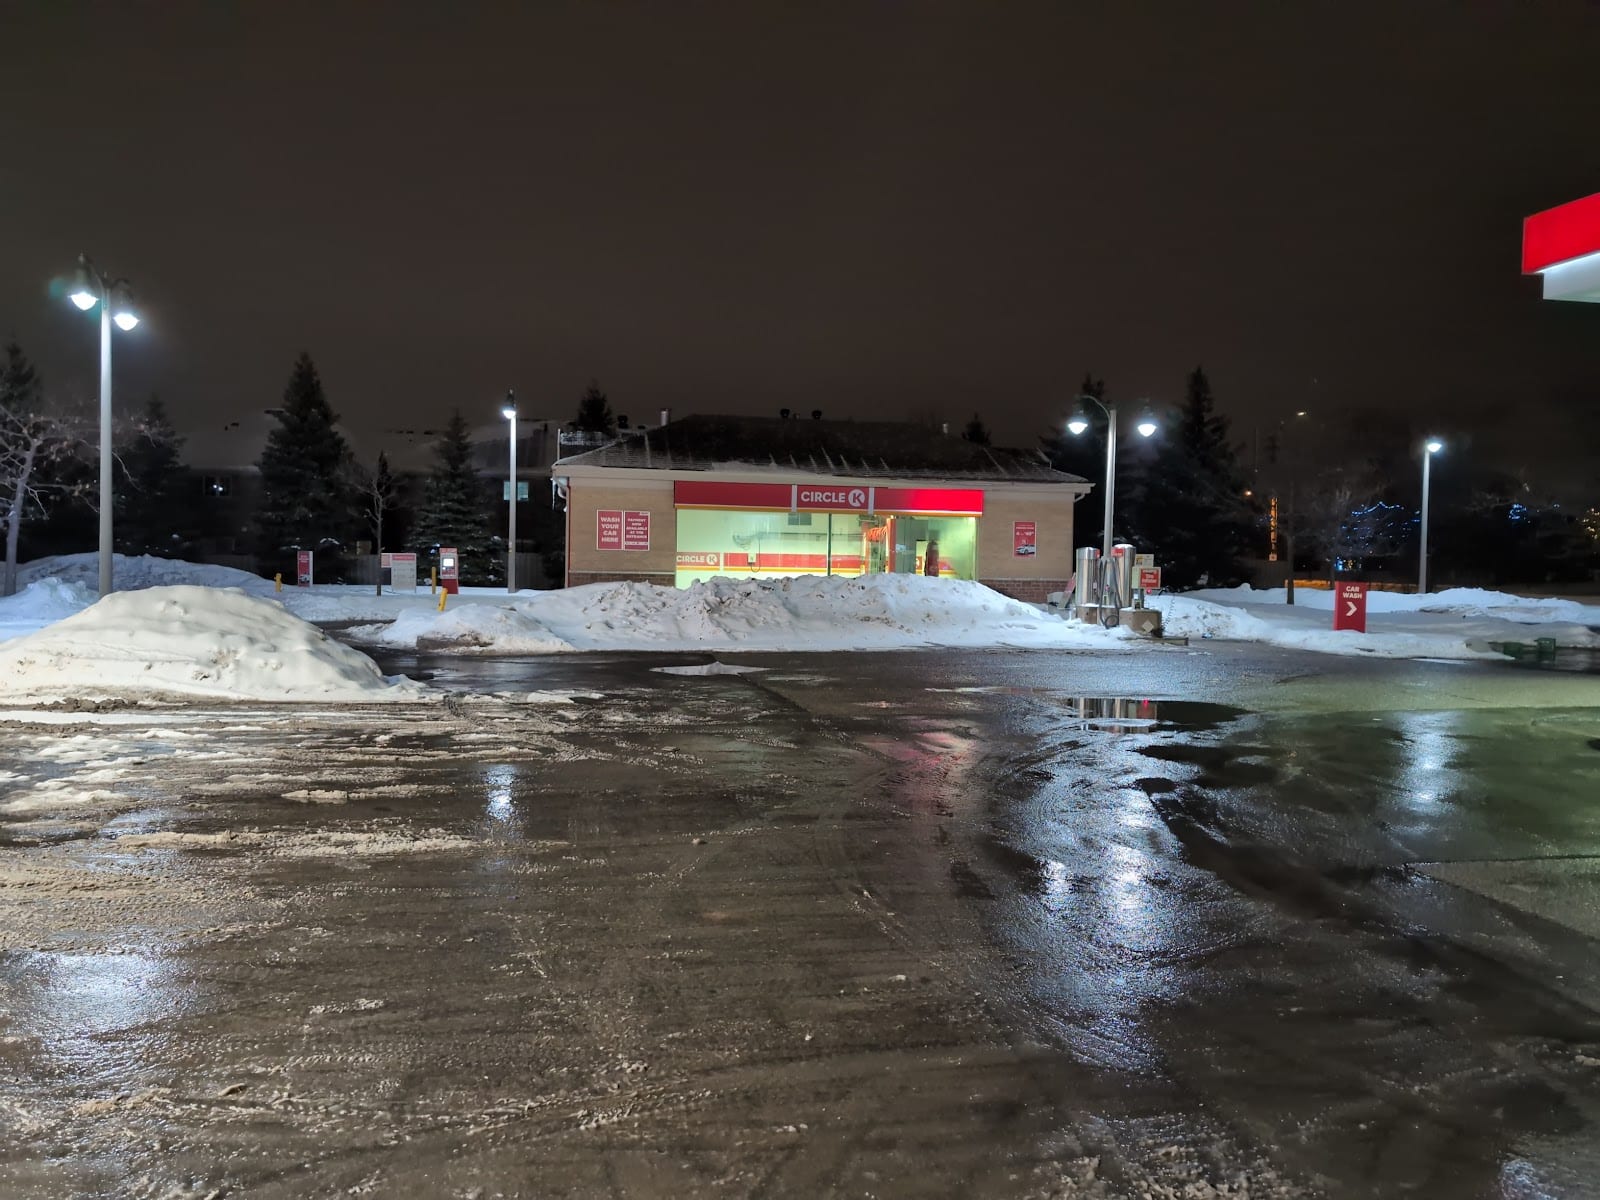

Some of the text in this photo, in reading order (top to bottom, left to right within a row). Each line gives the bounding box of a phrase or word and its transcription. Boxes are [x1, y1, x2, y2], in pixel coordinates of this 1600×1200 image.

[801, 490, 865, 506] CIRCLE K
[707, 554, 717, 565] K
